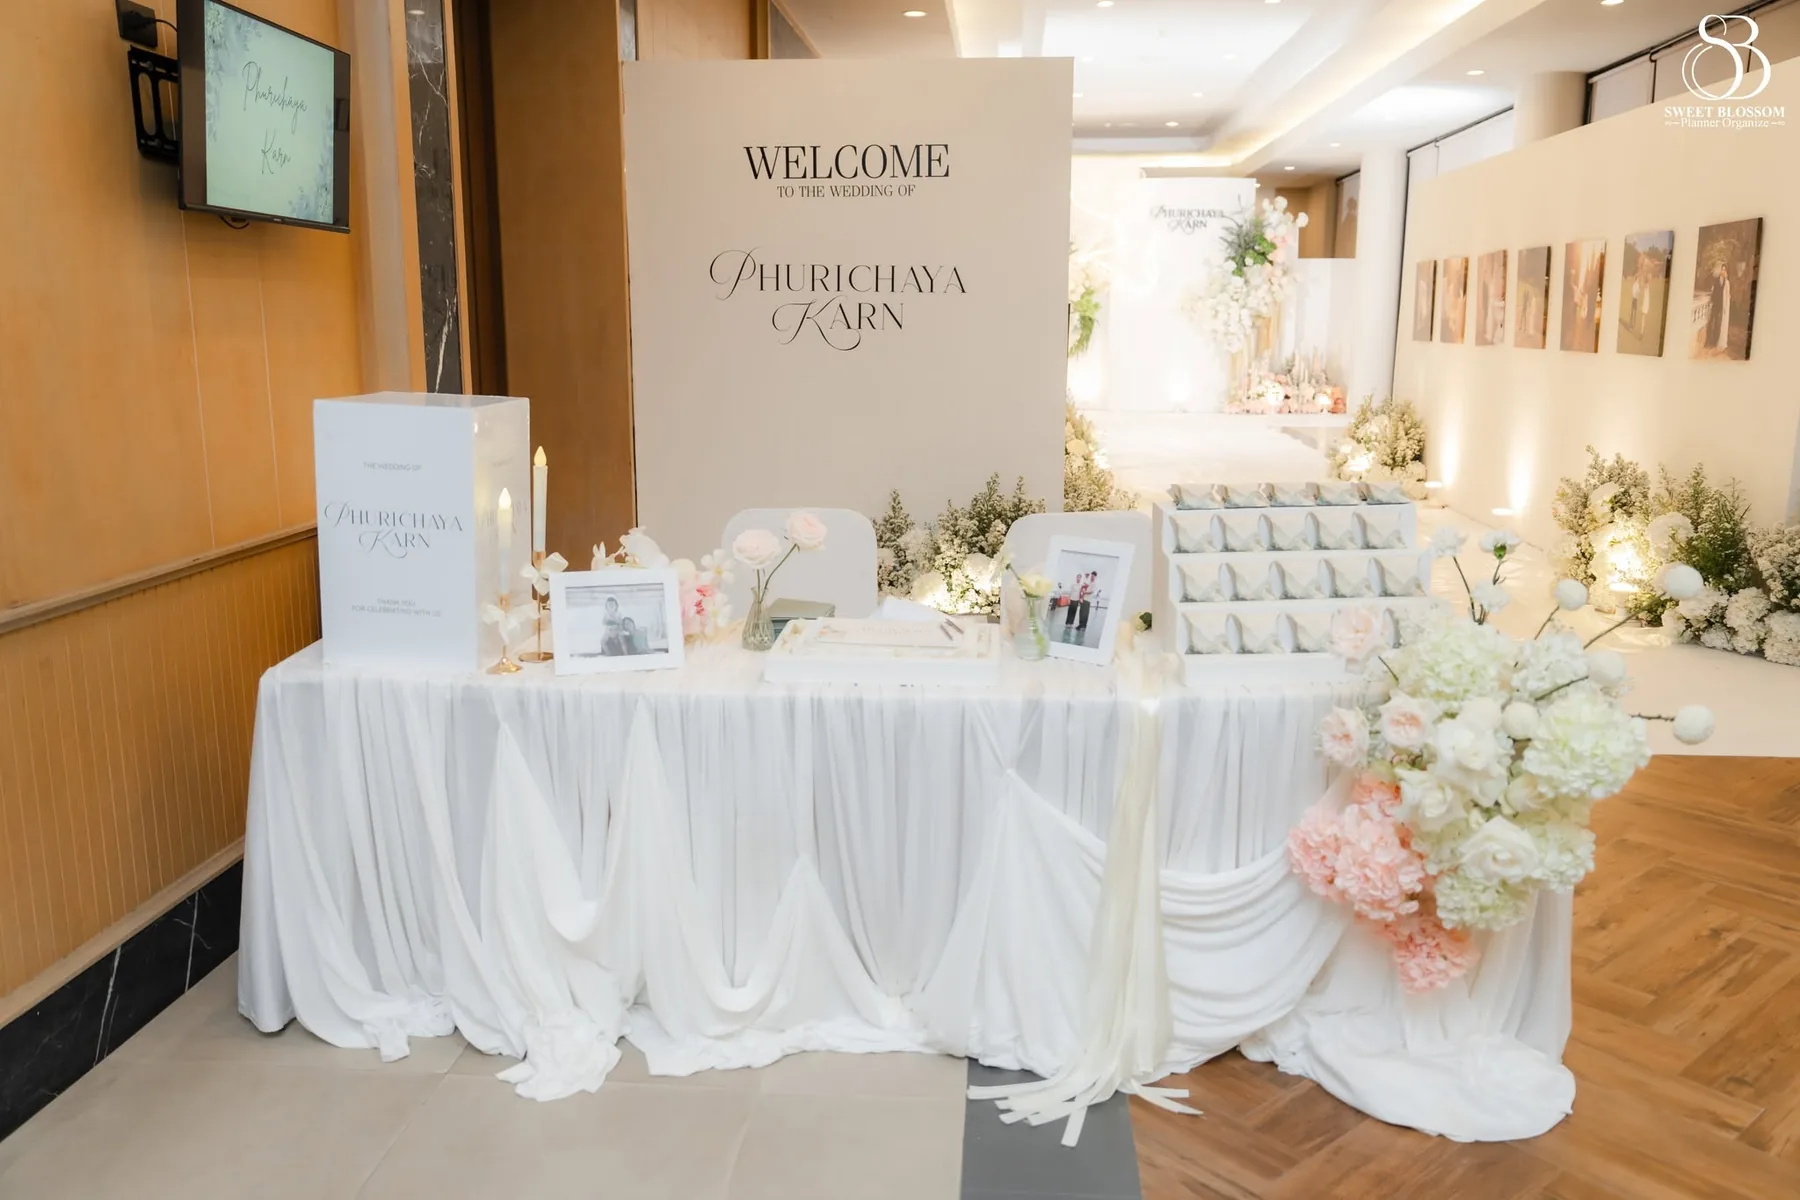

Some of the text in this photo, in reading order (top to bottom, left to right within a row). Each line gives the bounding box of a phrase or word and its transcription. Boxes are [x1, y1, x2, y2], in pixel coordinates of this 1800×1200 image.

[261, 129, 291, 175] Karn
[743, 144, 950, 180] WELCOME
[777, 184, 916, 198] TO THE WEDDING OF
[709, 247, 967, 301] PHURICHAYA
[772, 295, 904, 351] KARN
[324, 501, 463, 532] PHURICHAYA
[359, 529, 430, 559] KARN
